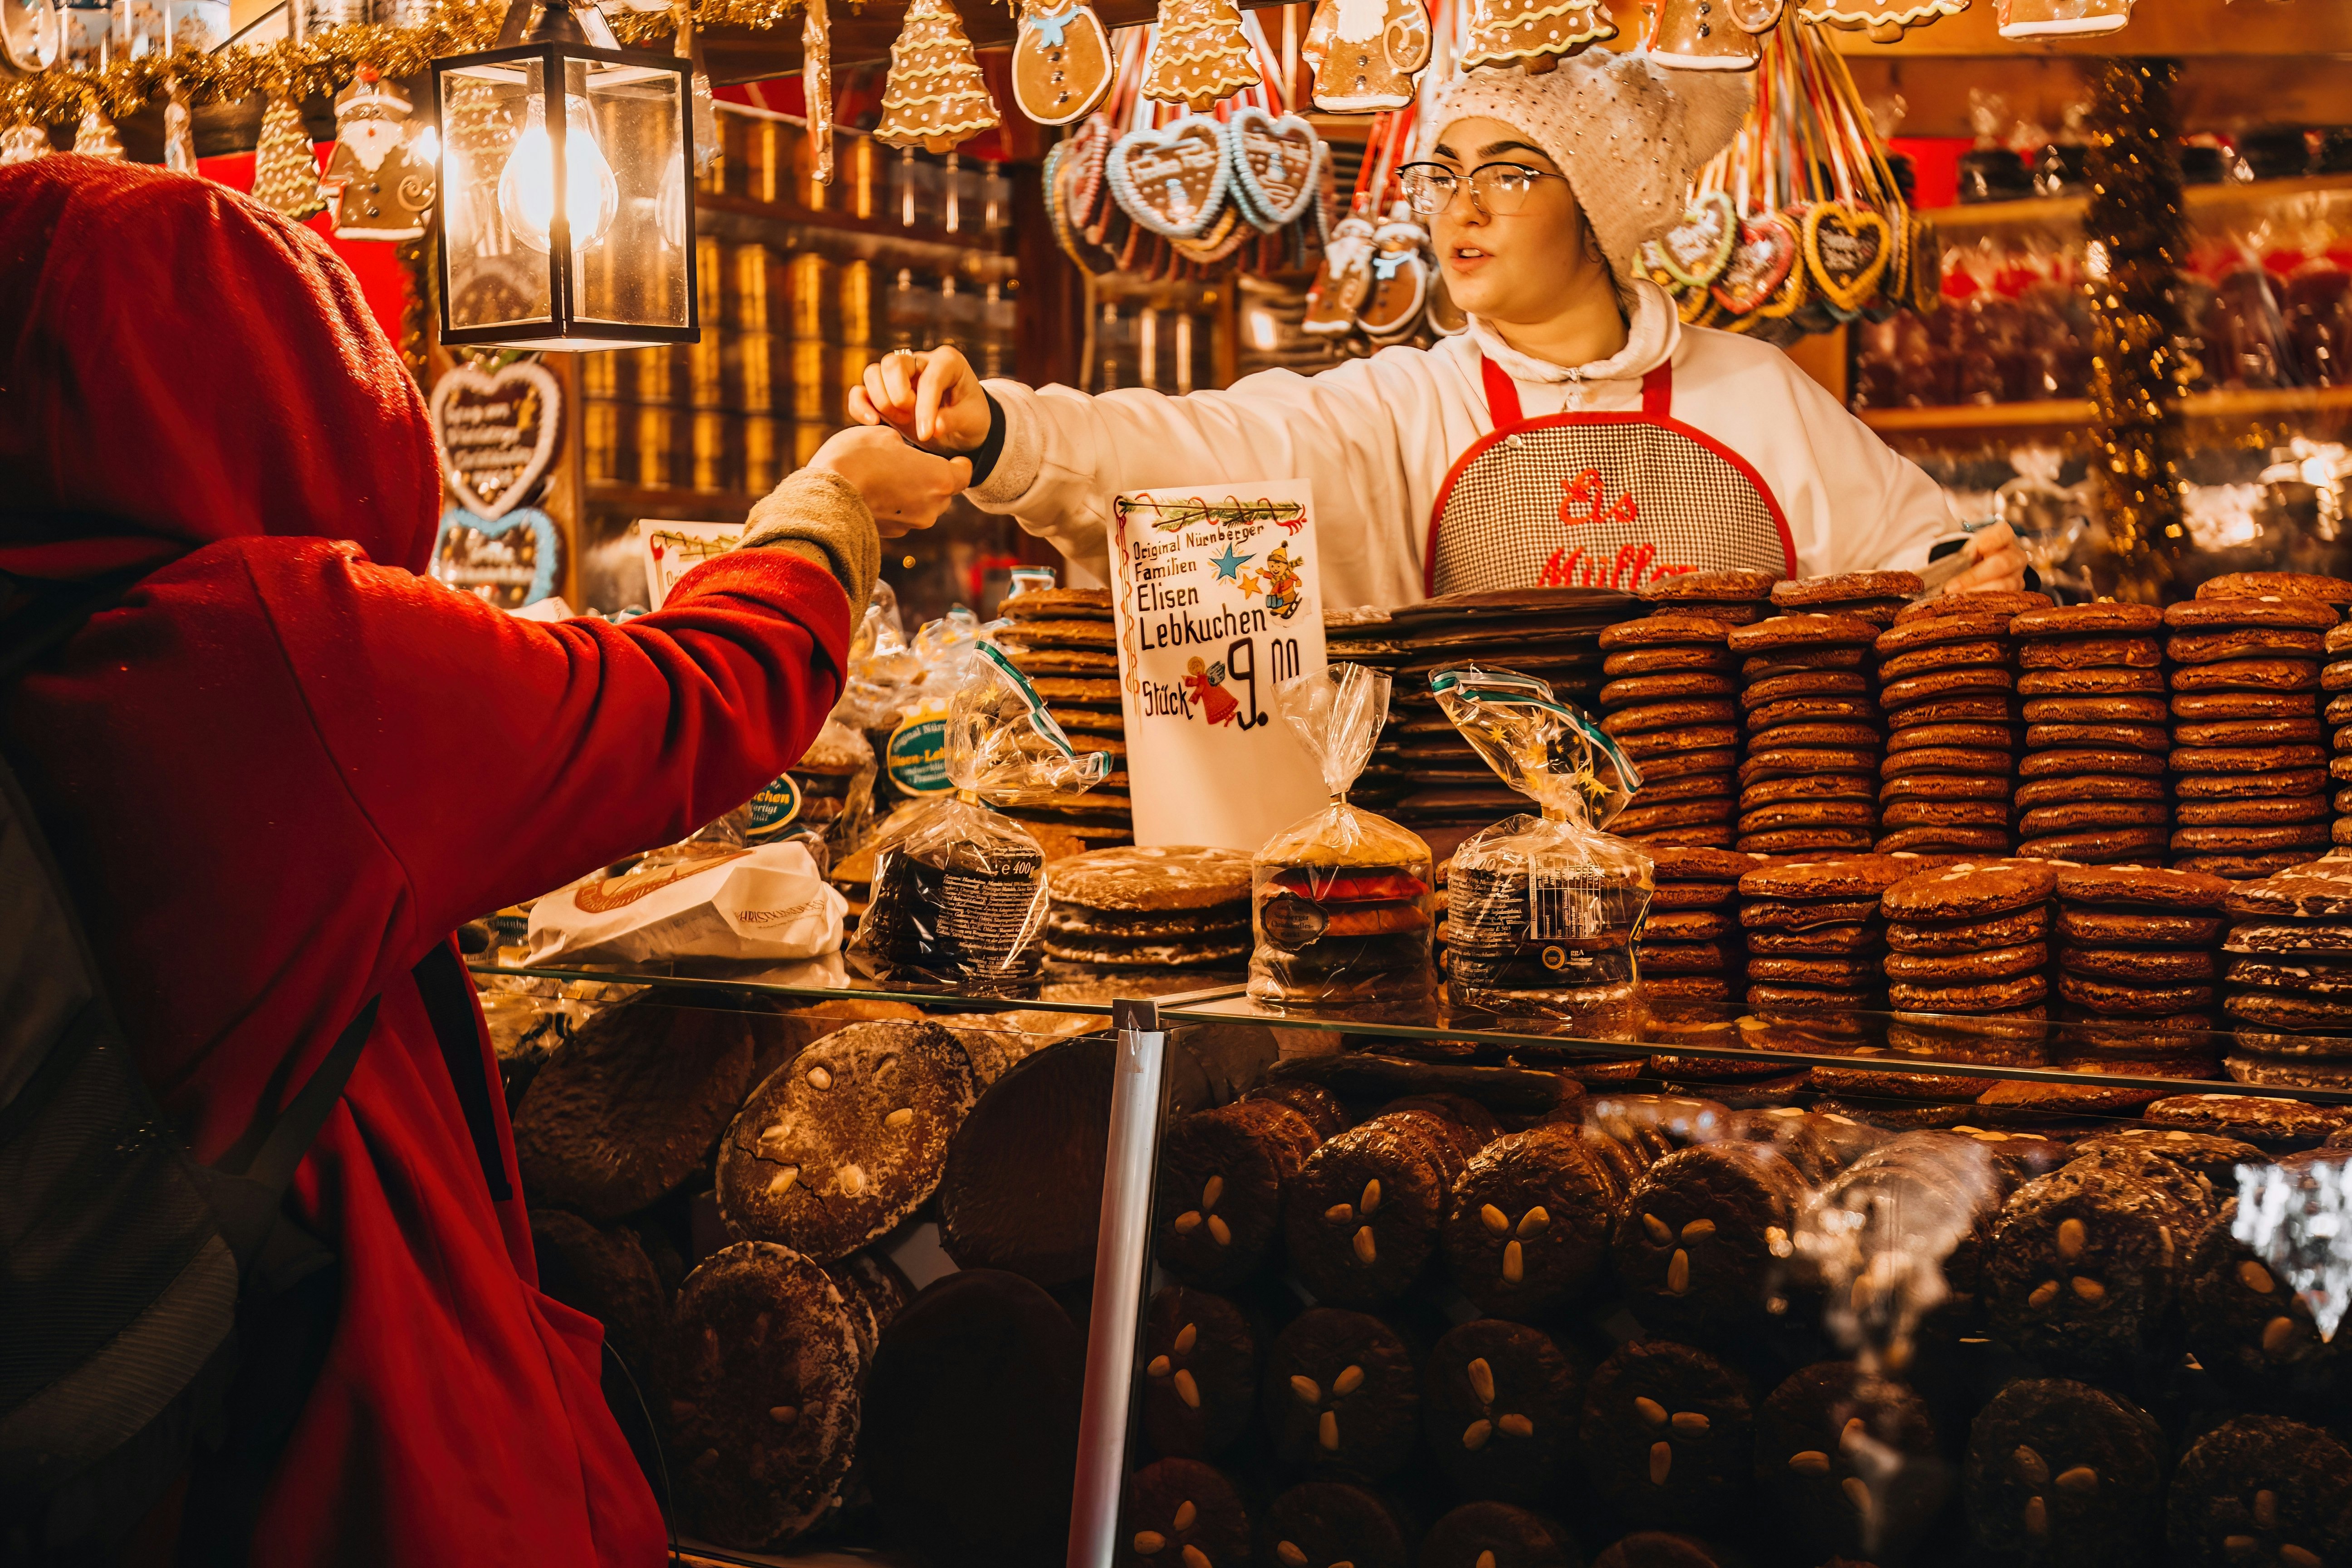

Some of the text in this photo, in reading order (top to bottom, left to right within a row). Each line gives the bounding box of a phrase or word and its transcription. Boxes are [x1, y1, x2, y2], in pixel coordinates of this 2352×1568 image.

[1133, 525, 1264, 561] Original Nürnberger
[1135, 557, 1197, 582] Familien
[1138, 584, 1199, 612] Elisen
[1140, 603, 1267, 651] Lebkuchen
[1142, 680, 1194, 720] Stück
